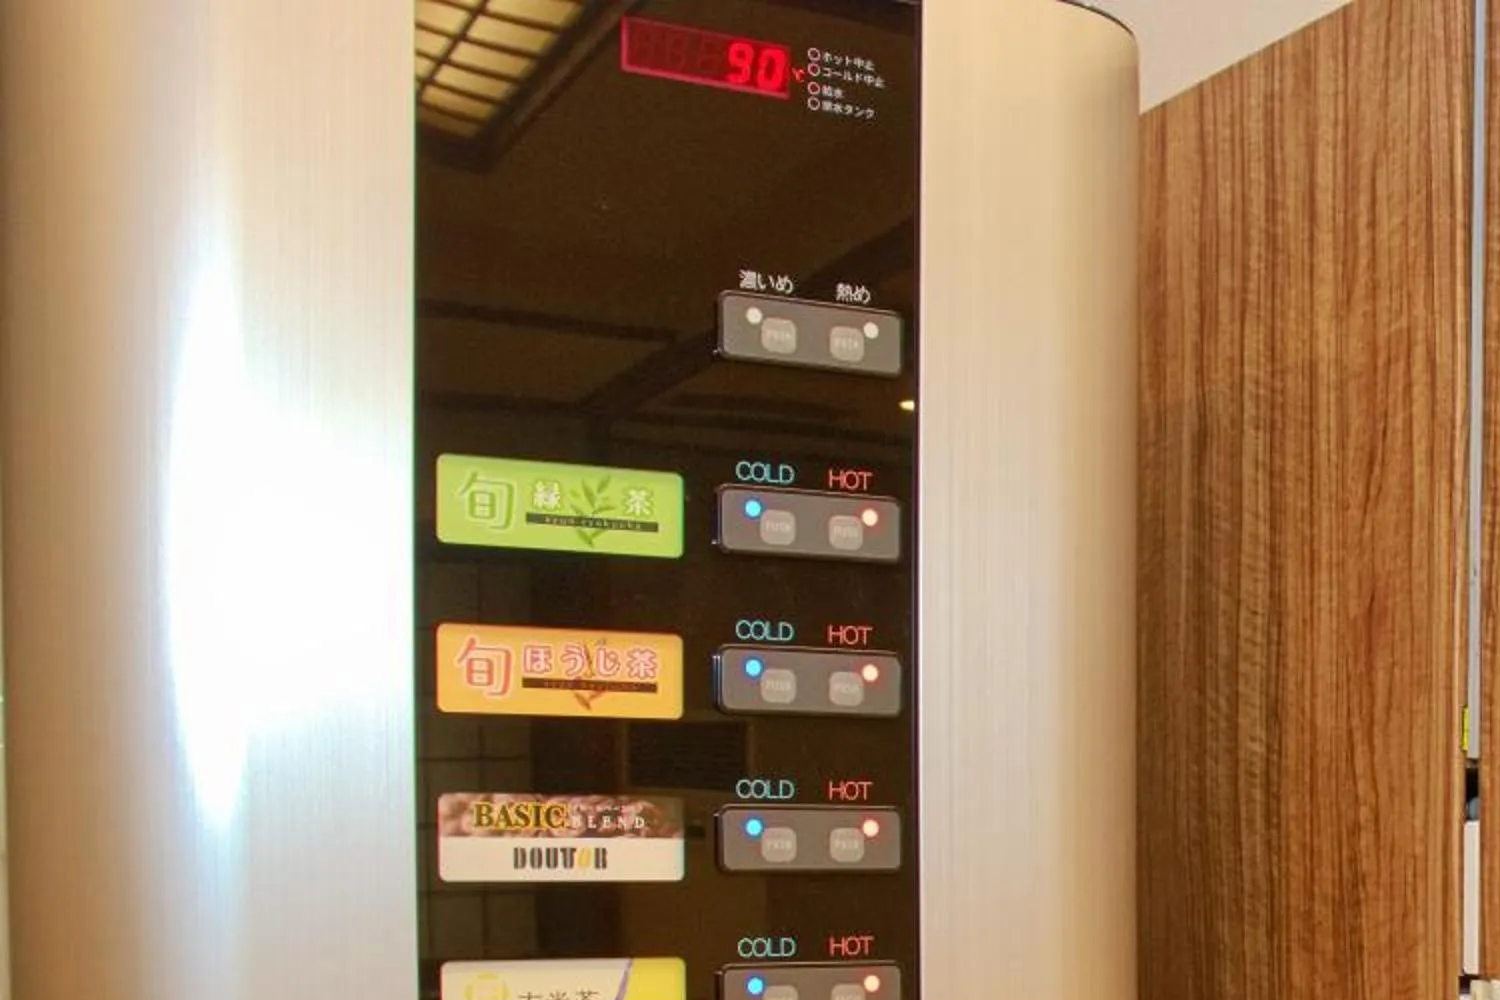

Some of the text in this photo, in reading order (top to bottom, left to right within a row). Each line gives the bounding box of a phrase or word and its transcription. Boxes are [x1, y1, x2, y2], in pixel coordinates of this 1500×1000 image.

[727, 42, 787, 91] 90
[738, 269, 873, 304] 濃いめ 熱め
[735, 461, 874, 492] COLD HOT
[459, 470, 516, 534] 旬
[735, 620, 873, 646] COLD HOT
[456, 636, 659, 699] 旬 ほうじ茶
[735, 779, 873, 801] COLD HOT
[473, 801, 567, 829] BASIC
[737, 936, 875, 959] COLD HOT
